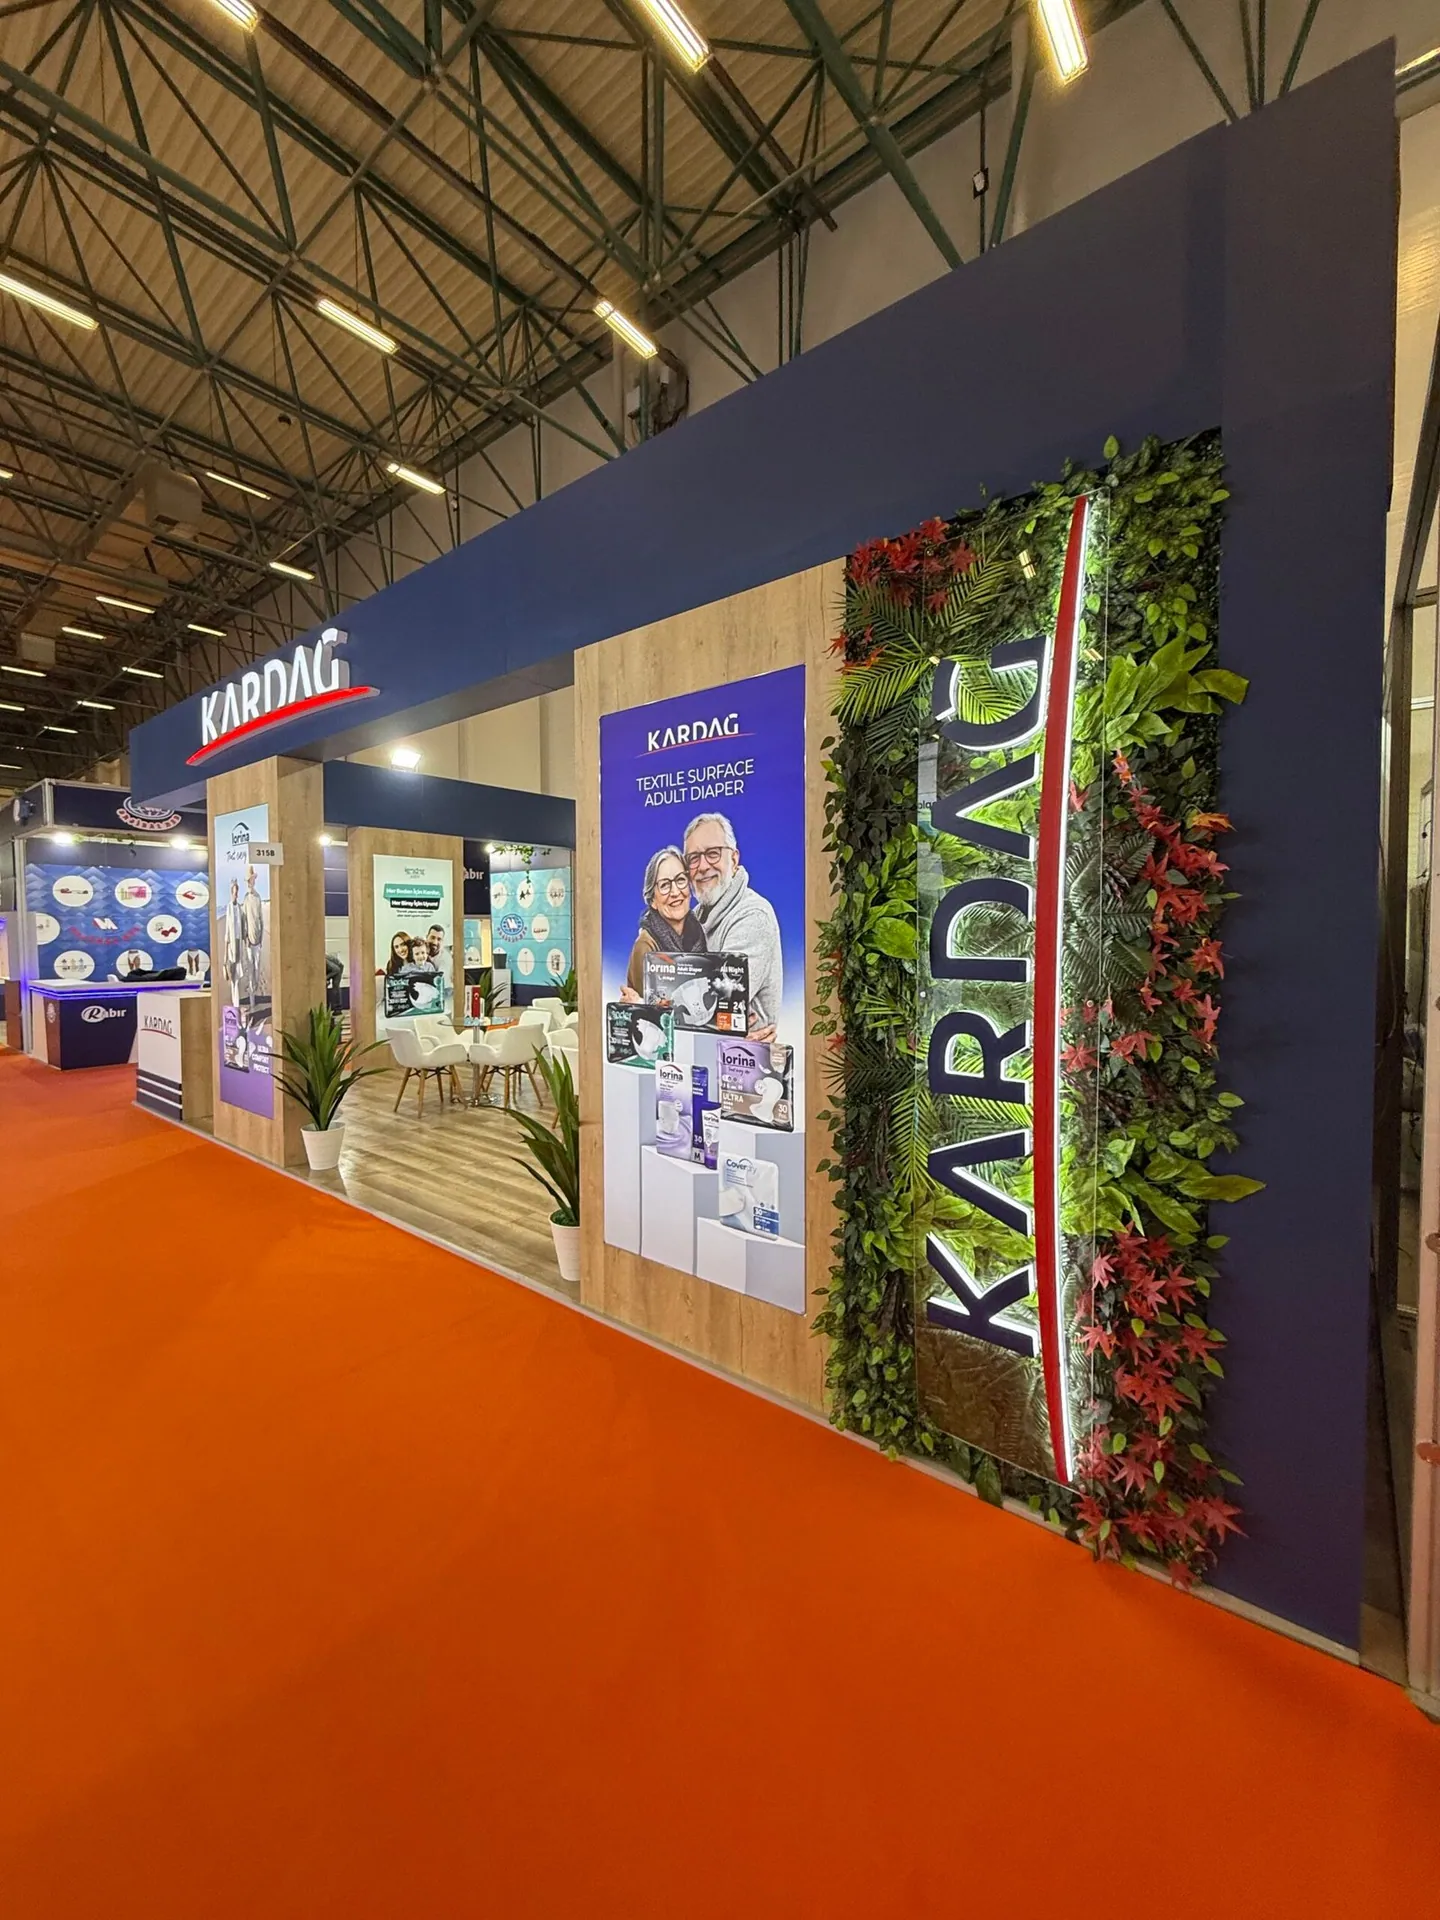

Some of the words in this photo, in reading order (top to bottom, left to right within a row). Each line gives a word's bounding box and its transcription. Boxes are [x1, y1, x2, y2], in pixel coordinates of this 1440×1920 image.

[636, 771, 685, 791] TEXTILE
[687, 758, 755, 784] SURFACE
[644, 788, 688, 807] ADULT
[690, 779, 745, 801] DIAPER
[231, 831, 250, 845] lorina
[256, 849, 276, 857] 315B
[463, 867, 485, 880] abır
[728, 966, 744, 974] Night
[723, 1053, 756, 1067] lorina
[660, 1069, 684, 1081] lorina
[723, 1093, 744, 1103] ULTRA
[778, 1103, 788, 1114] 30
